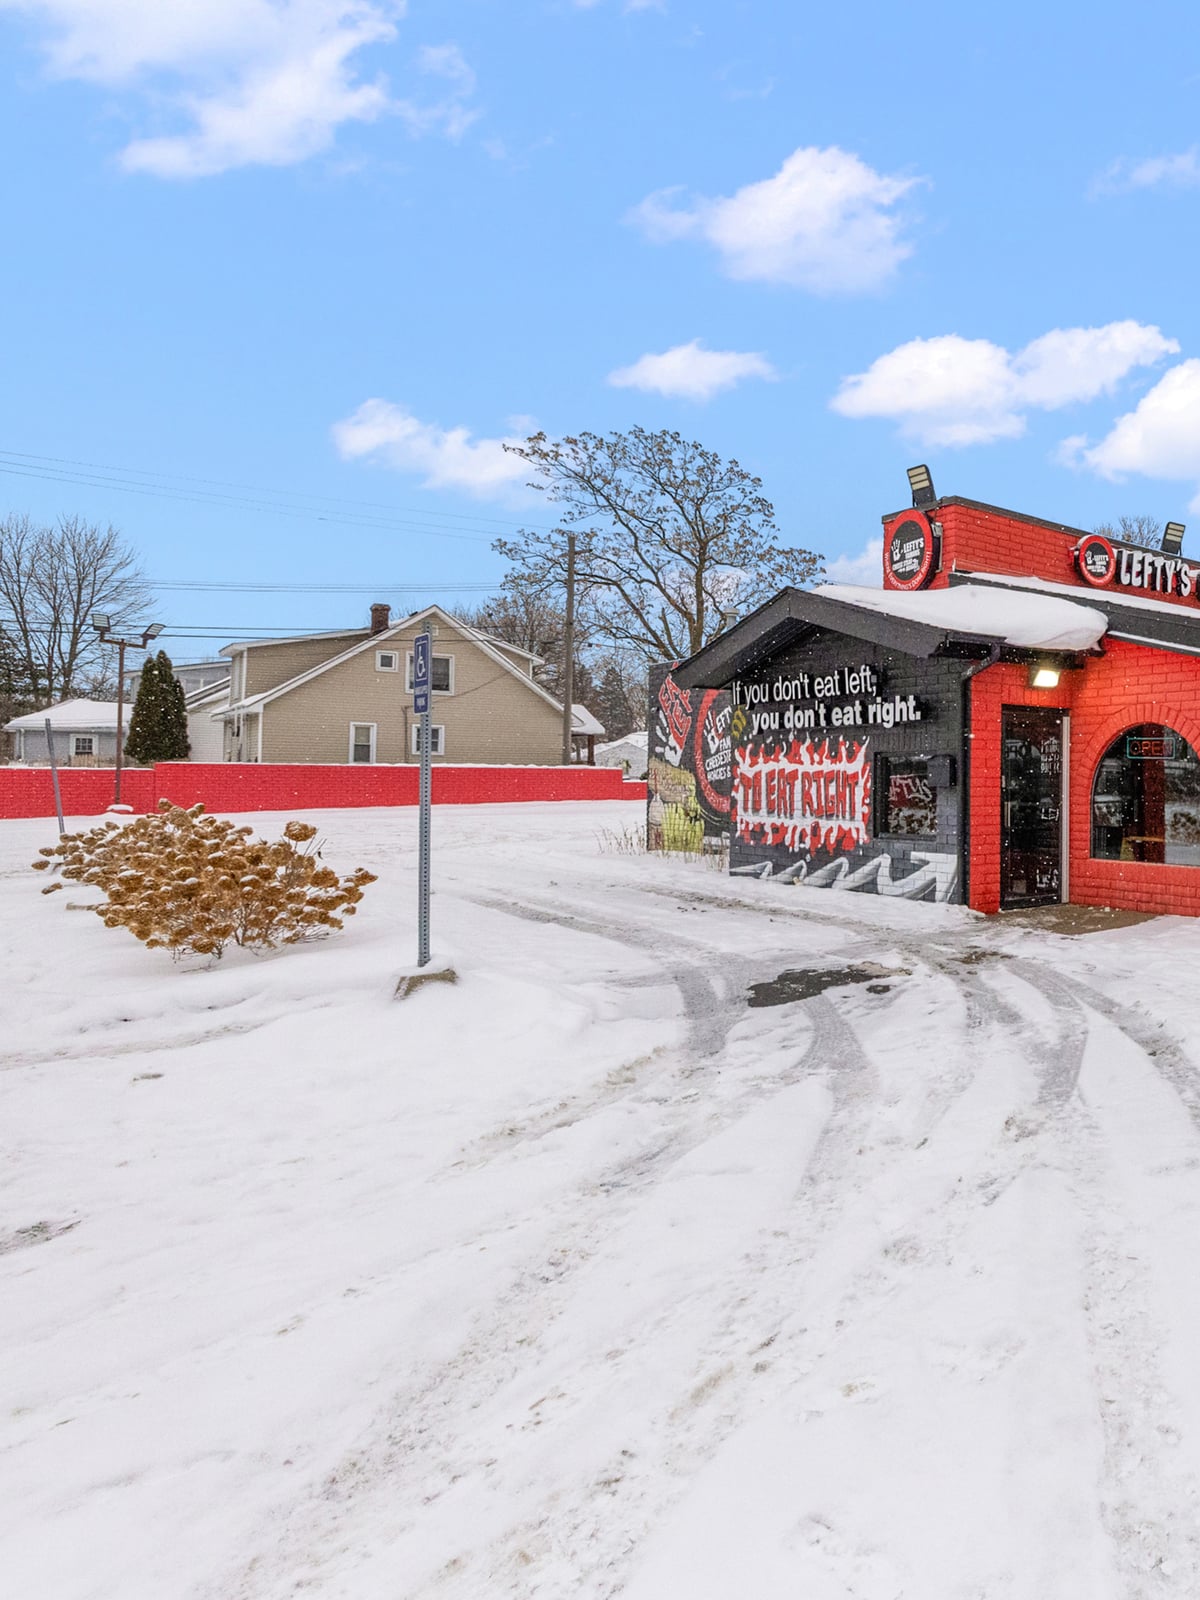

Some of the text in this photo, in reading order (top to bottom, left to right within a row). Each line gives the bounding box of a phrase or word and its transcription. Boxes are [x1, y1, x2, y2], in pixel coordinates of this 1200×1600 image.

[1119, 549, 1192, 597] LEFTY'S
[732, 681, 742, 705] If
[743, 682, 769, 710] you
[773, 672, 810, 702] don't
[813, 670, 841, 698] eat
[752, 694, 922, 735] you don't eat right.
[1130, 740, 1173, 756] OPEN
[739, 770, 763, 815] TO
[766, 768, 800, 819] EAT
[801, 769, 860, 819] RIGHT
